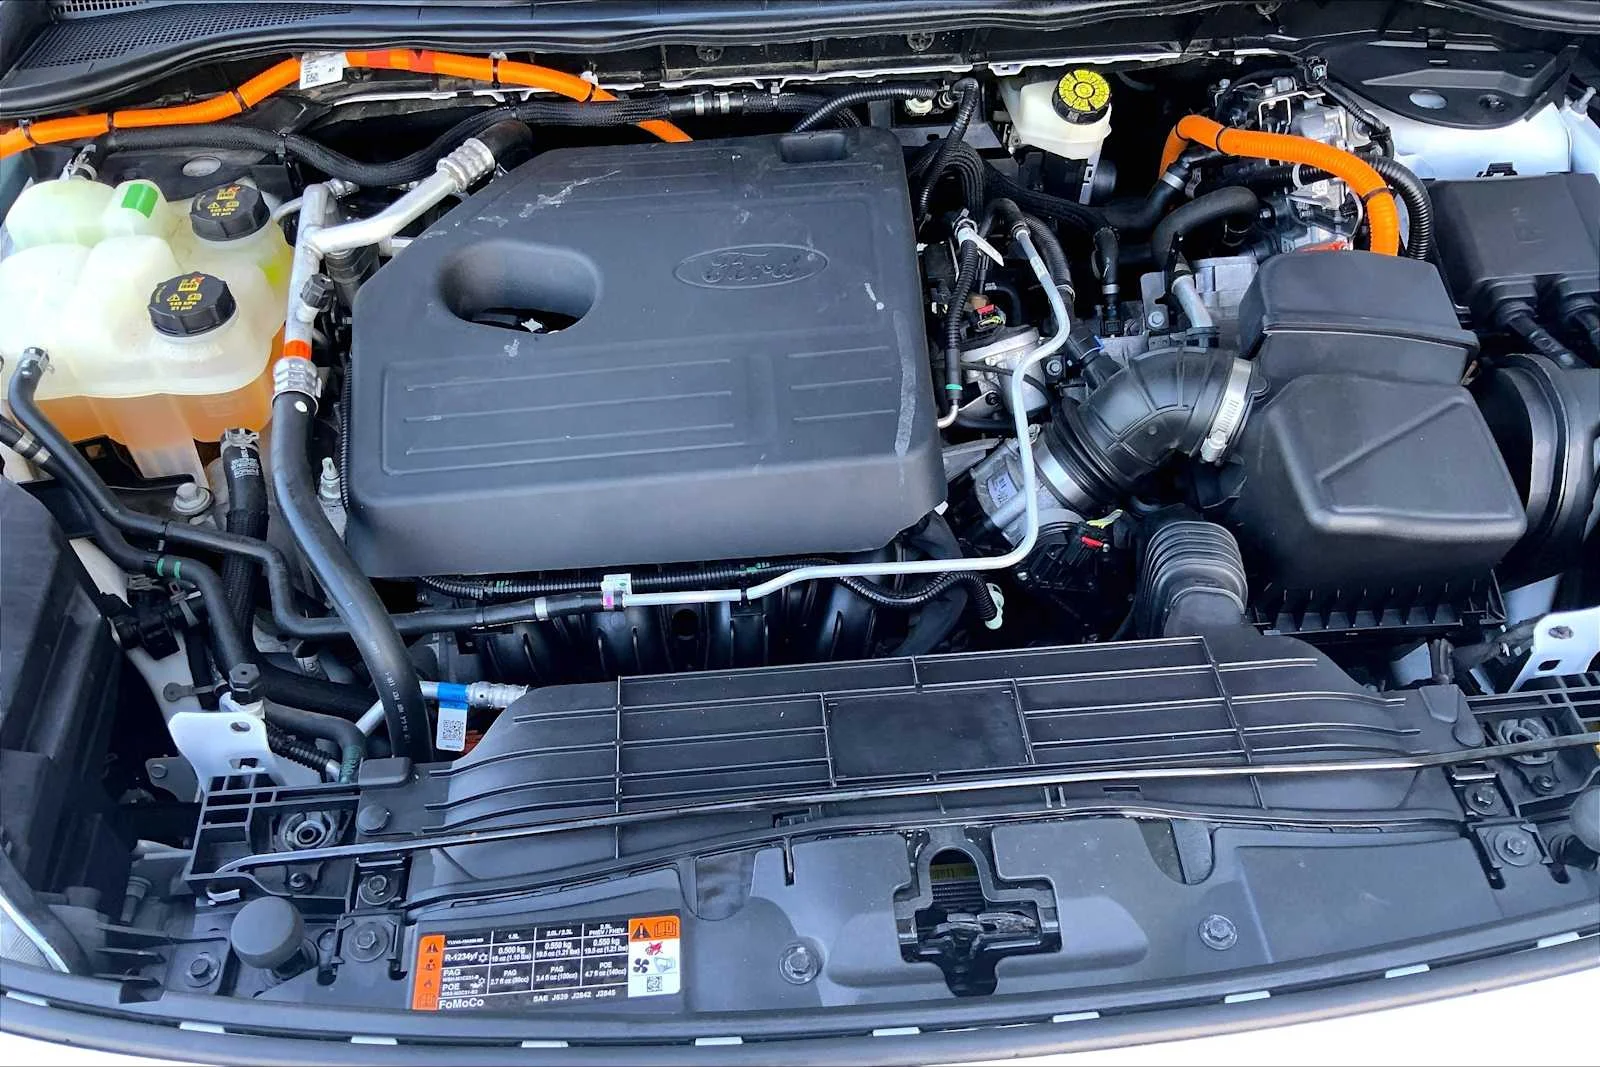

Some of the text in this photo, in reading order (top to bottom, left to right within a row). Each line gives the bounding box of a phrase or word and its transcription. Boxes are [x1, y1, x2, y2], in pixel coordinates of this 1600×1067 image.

[701, 252, 801, 283] Ford
[563, 941, 572, 950] kg
[611, 937, 620, 946] kg
[517, 946, 526, 954] kg
[445, 951, 479, 962] R-1234yf
[444, 968, 461, 977] PAG
[442, 983, 460, 991] POE
[439, 997, 484, 1010] FoMoCo
[533, 995, 549, 1003] SAE
